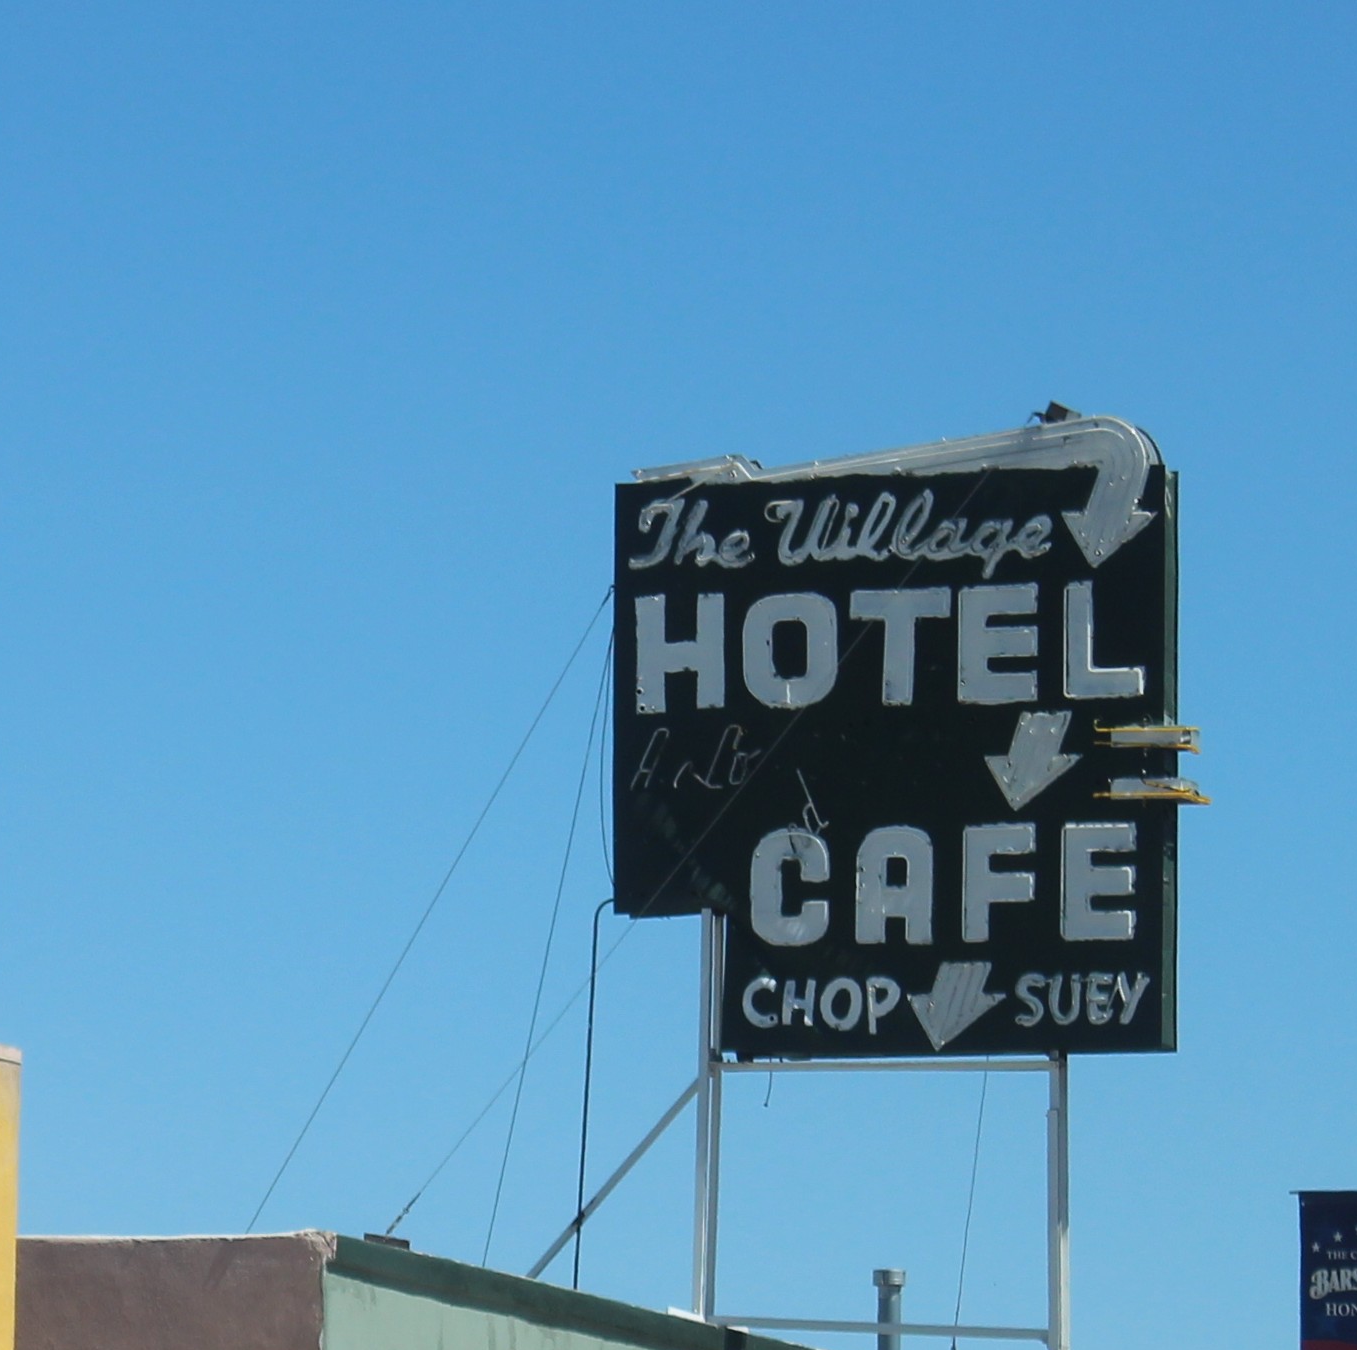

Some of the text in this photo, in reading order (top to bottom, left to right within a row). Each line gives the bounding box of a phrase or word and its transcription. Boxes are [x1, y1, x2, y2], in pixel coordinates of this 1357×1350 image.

[629, 498, 755, 569] The
[634, 580, 1145, 715] HOTEL
[749, 821, 1136, 946] CAFE
[742, 971, 1151, 1034] CHOP SUEY
[1326, 1250, 1349, 1260] THE
